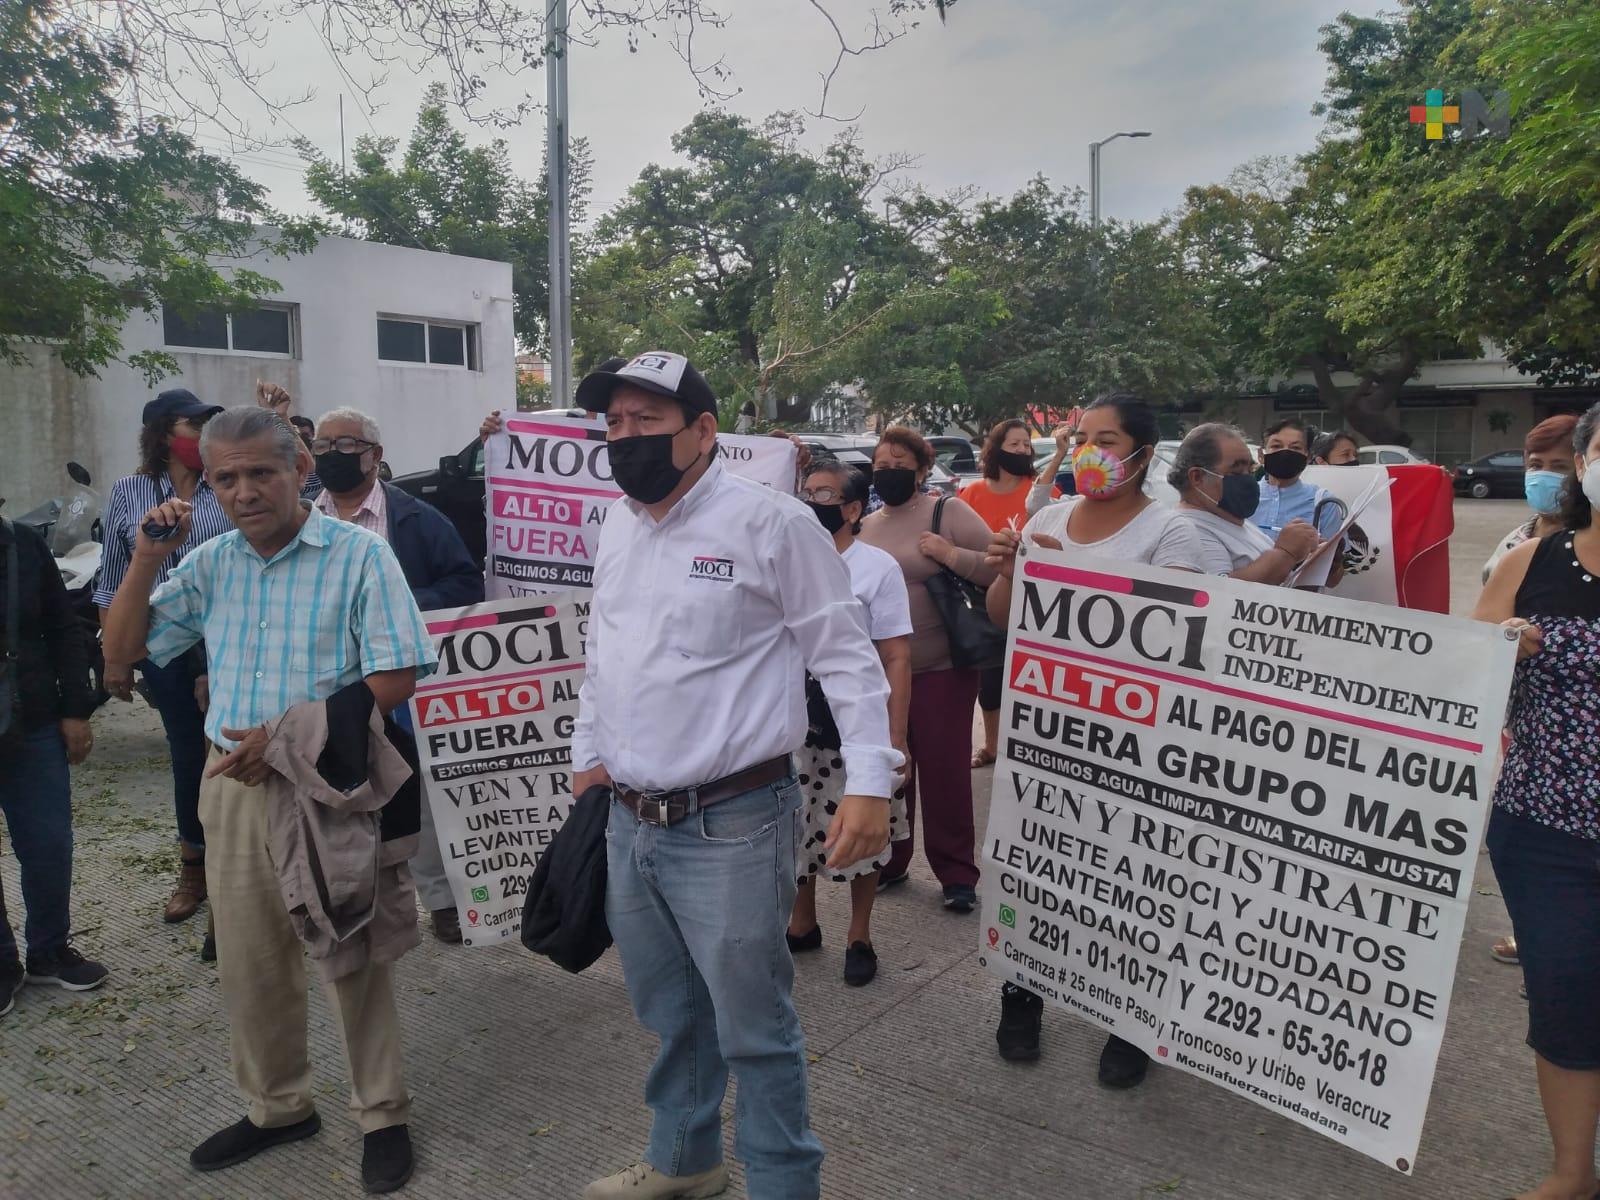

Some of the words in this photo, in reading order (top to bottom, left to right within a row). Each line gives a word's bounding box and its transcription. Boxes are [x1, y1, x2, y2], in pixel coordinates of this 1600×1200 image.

[505, 434, 614, 481] MOC
[503, 496, 570, 521] ALTO
[493, 524, 589, 559] FUERA
[496, 562, 558, 580] EXIGIMOS
[562, 569, 593, 584] AGU
[1228, 628, 1303, 661] CIVIL
[1232, 599, 1433, 655] MOVIMIENTO
[424, 685, 540, 724] ALTO
[1222, 655, 1479, 729] INDEPENDIENTE
[428, 720, 543, 757] FUERA
[1014, 659, 1153, 718] ALTO
[1167, 695, 1202, 732] AL
[1211, 705, 1295, 752] PAGO
[1304, 727, 1366, 773] DEL
[1376, 747, 1478, 801] AGUA
[438, 759, 508, 778] EXIGIMOS
[513, 753, 552, 767] AGUA
[1011, 701, 1142, 767] FUERA
[1157, 744, 1326, 816] GRUPO
[1344, 793, 1468, 855] MAS
[443, 778, 510, 808] VEN
[518, 774, 539, 798] Y
[466, 808, 540, 831] UNETE
[547, 805, 563, 822] A
[1014, 744, 1093, 781] EXIGIMOS
[1098, 773, 1145, 799] AGUA
[1152, 788, 1214, 820] LIMPIA
[1222, 808, 1237, 825] Y
[1240, 816, 1284, 842] UNA
[1291, 830, 1366, 868] TARIFA
[1375, 857, 1454, 892] JUSTA
[450, 829, 558, 859] LEVANTE
[1011, 771, 1087, 824] VEN
[1095, 800, 1122, 836] Y
[1128, 812, 1439, 940] REGISTRATE
[500, 875, 532, 899] 229
[1021, 818, 1109, 870] UNETE
[1113, 855, 1133, 881] A
[1142, 863, 1221, 910] MOCI
[1231, 892, 1252, 919] Y
[1258, 907, 1406, 971] JUNTOS
[992, 839, 1176, 928] LEVANTEMOS
[1185, 911, 1225, 947] LA
[1235, 932, 1371, 995] CIUDAD
[1384, 980, 1437, 1019] DE
[1000, 872, 1160, 954] CIUDADANO
[1167, 942, 1189, 967] A
[1199, 952, 1412, 1046] CIUDADANO
[1029, 915, 1069, 956] 2291
[1088, 941, 1168, 999] 01-10-77
[1179, 979, 1196, 1010] Y
[1204, 991, 1261, 1037] 2292
[1282, 1020, 1387, 1087] 65-36-18
[1029, 978, 1058, 1000] MOCI
[1062, 994, 1116, 1027] Veracruz
[1004, 941, 1055, 978] Carranza
[1058, 967, 1066, 984] #
[1070, 972, 1085, 992] 25
[1088, 980, 1122, 1010] entre
[1125, 997, 1156, 1029] Paso
[1170, 1020, 1242, 1066] Troncoso
[1246, 1053, 1257, 1075] y
[1262, 1056, 1306, 1091] Uribe
[1316, 1078, 1392, 1129] Veracruz
[1175, 1052, 1348, 1135] Mocilafuerzaciudadana
